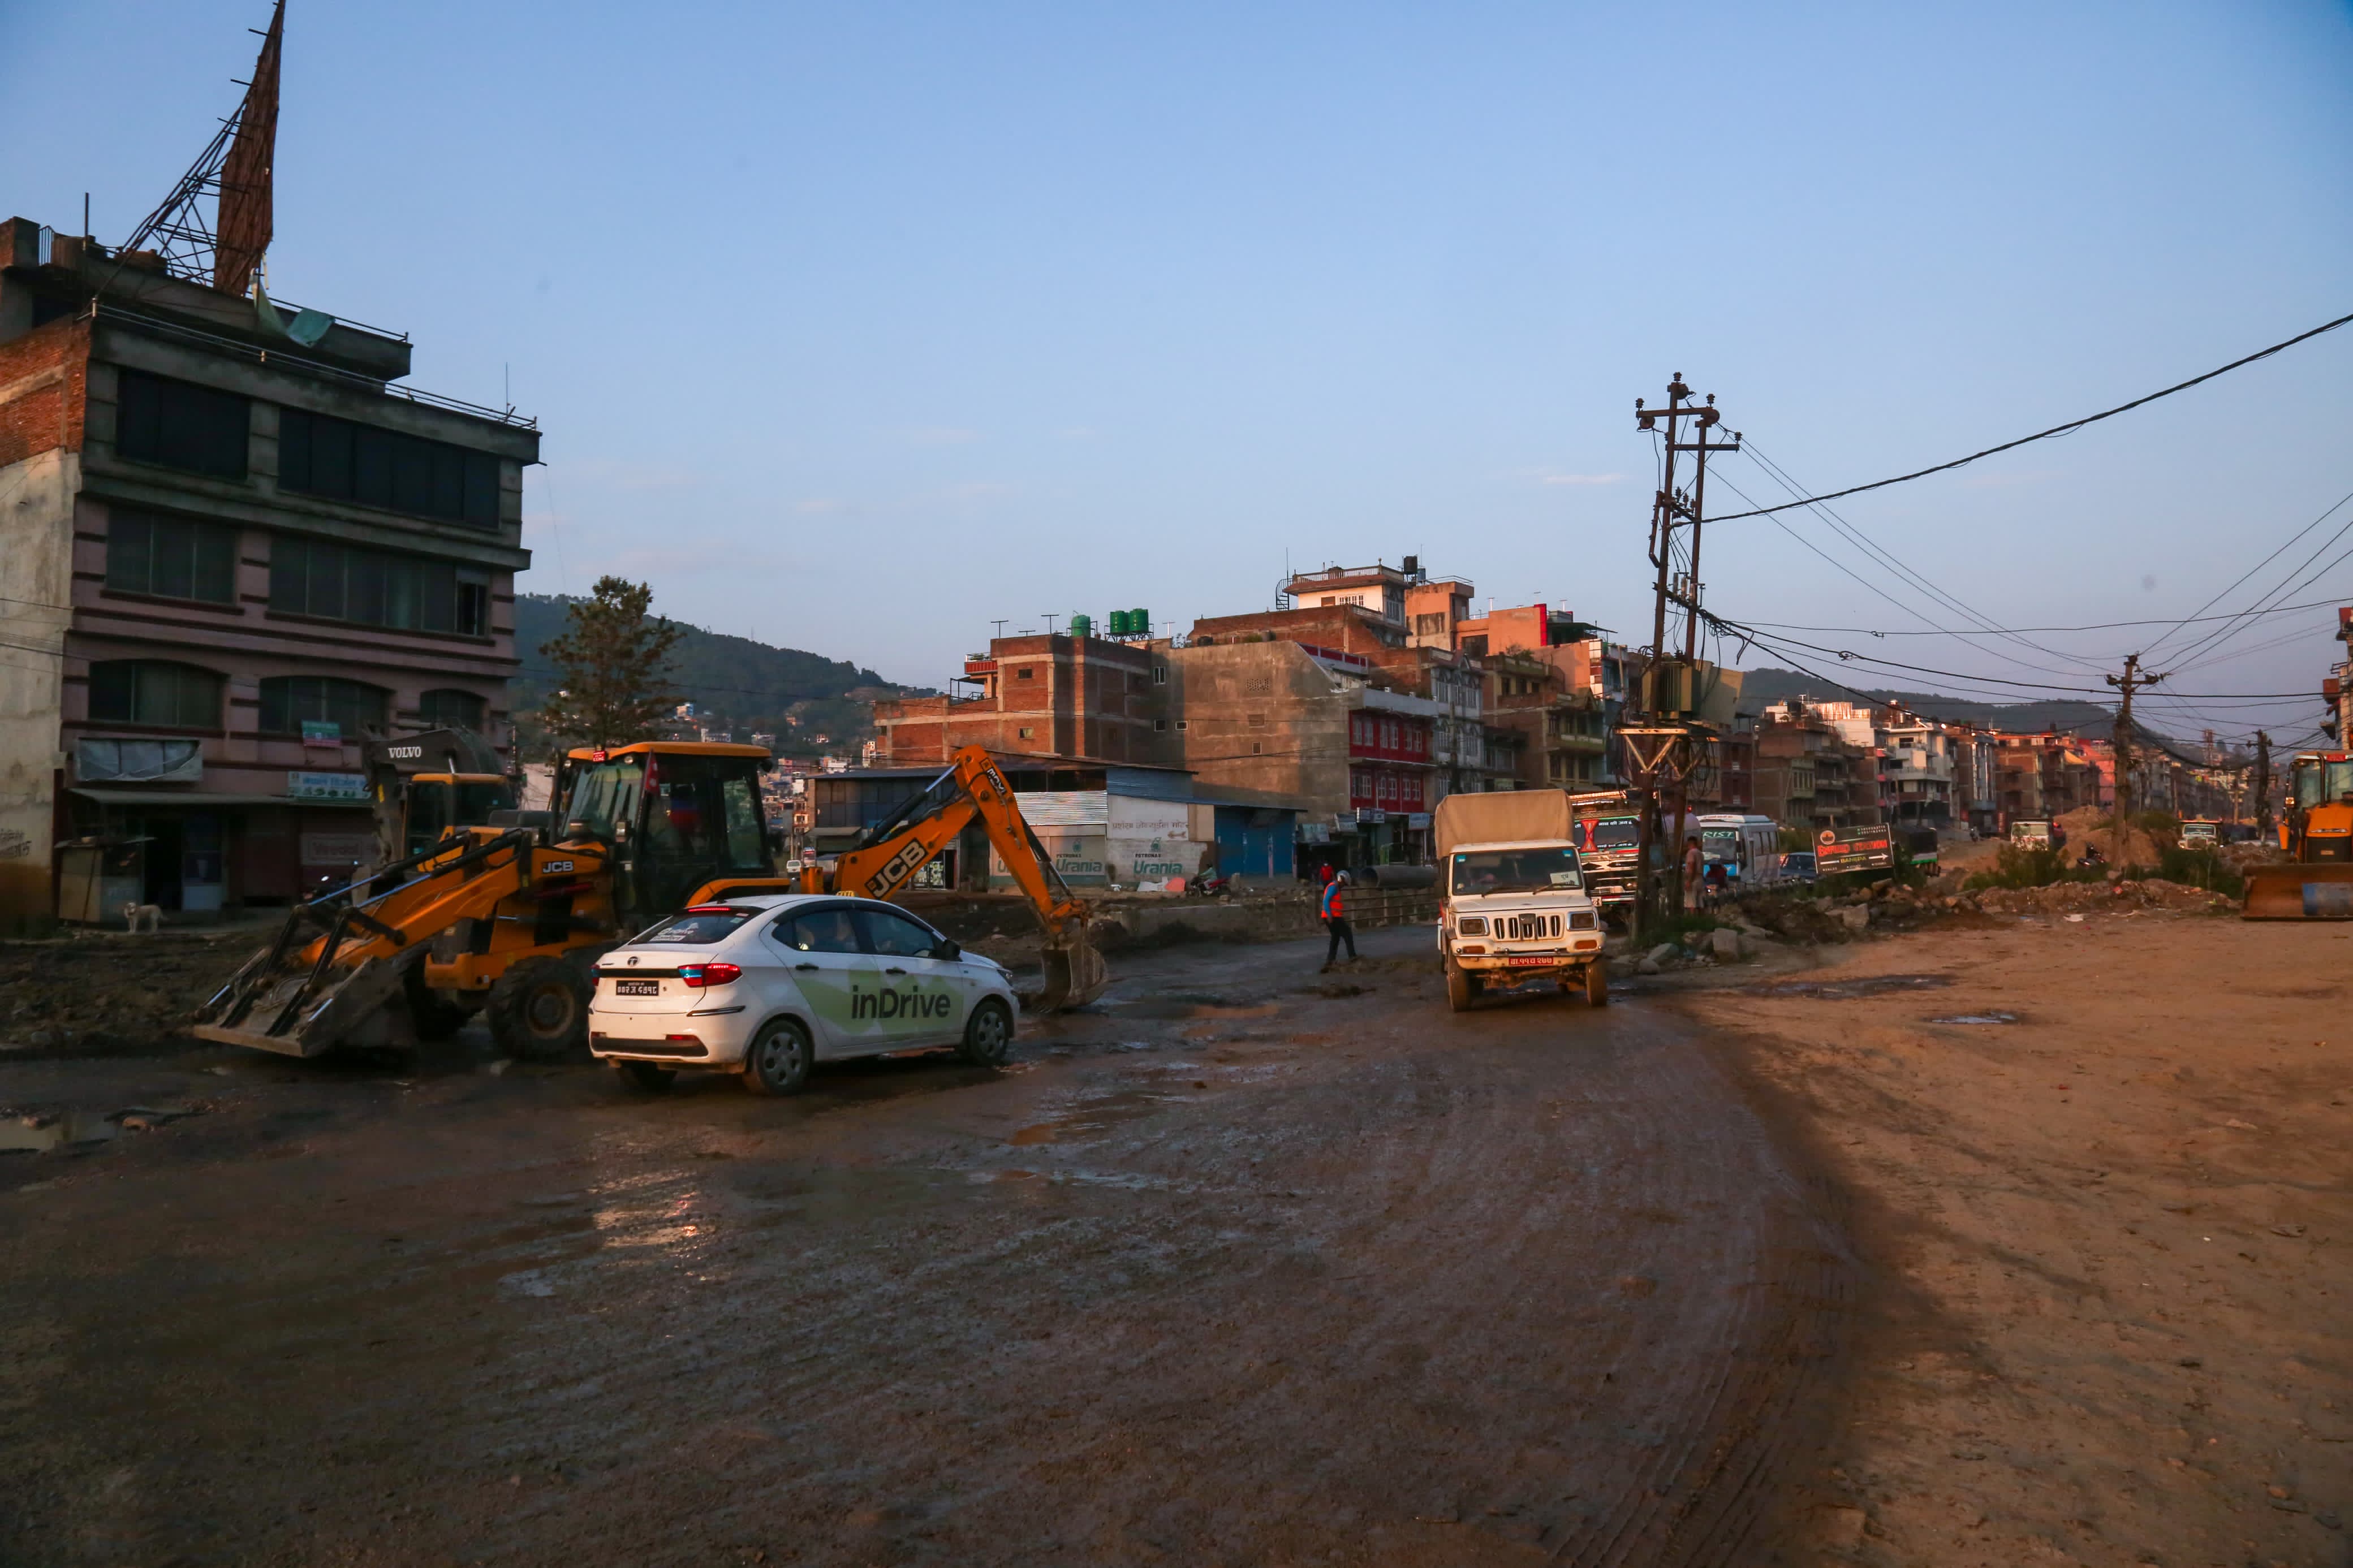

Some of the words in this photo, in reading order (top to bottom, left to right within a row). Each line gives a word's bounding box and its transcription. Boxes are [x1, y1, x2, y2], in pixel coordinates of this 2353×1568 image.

[388, 746, 421, 758] VOLVO
[543, 861, 574, 873] JCB
[873, 841, 925, 898] JCB
[1056, 858, 1102, 872] Urania
[1134, 860, 1183, 874] Urania
[851, 985, 951, 1019] inDrive
